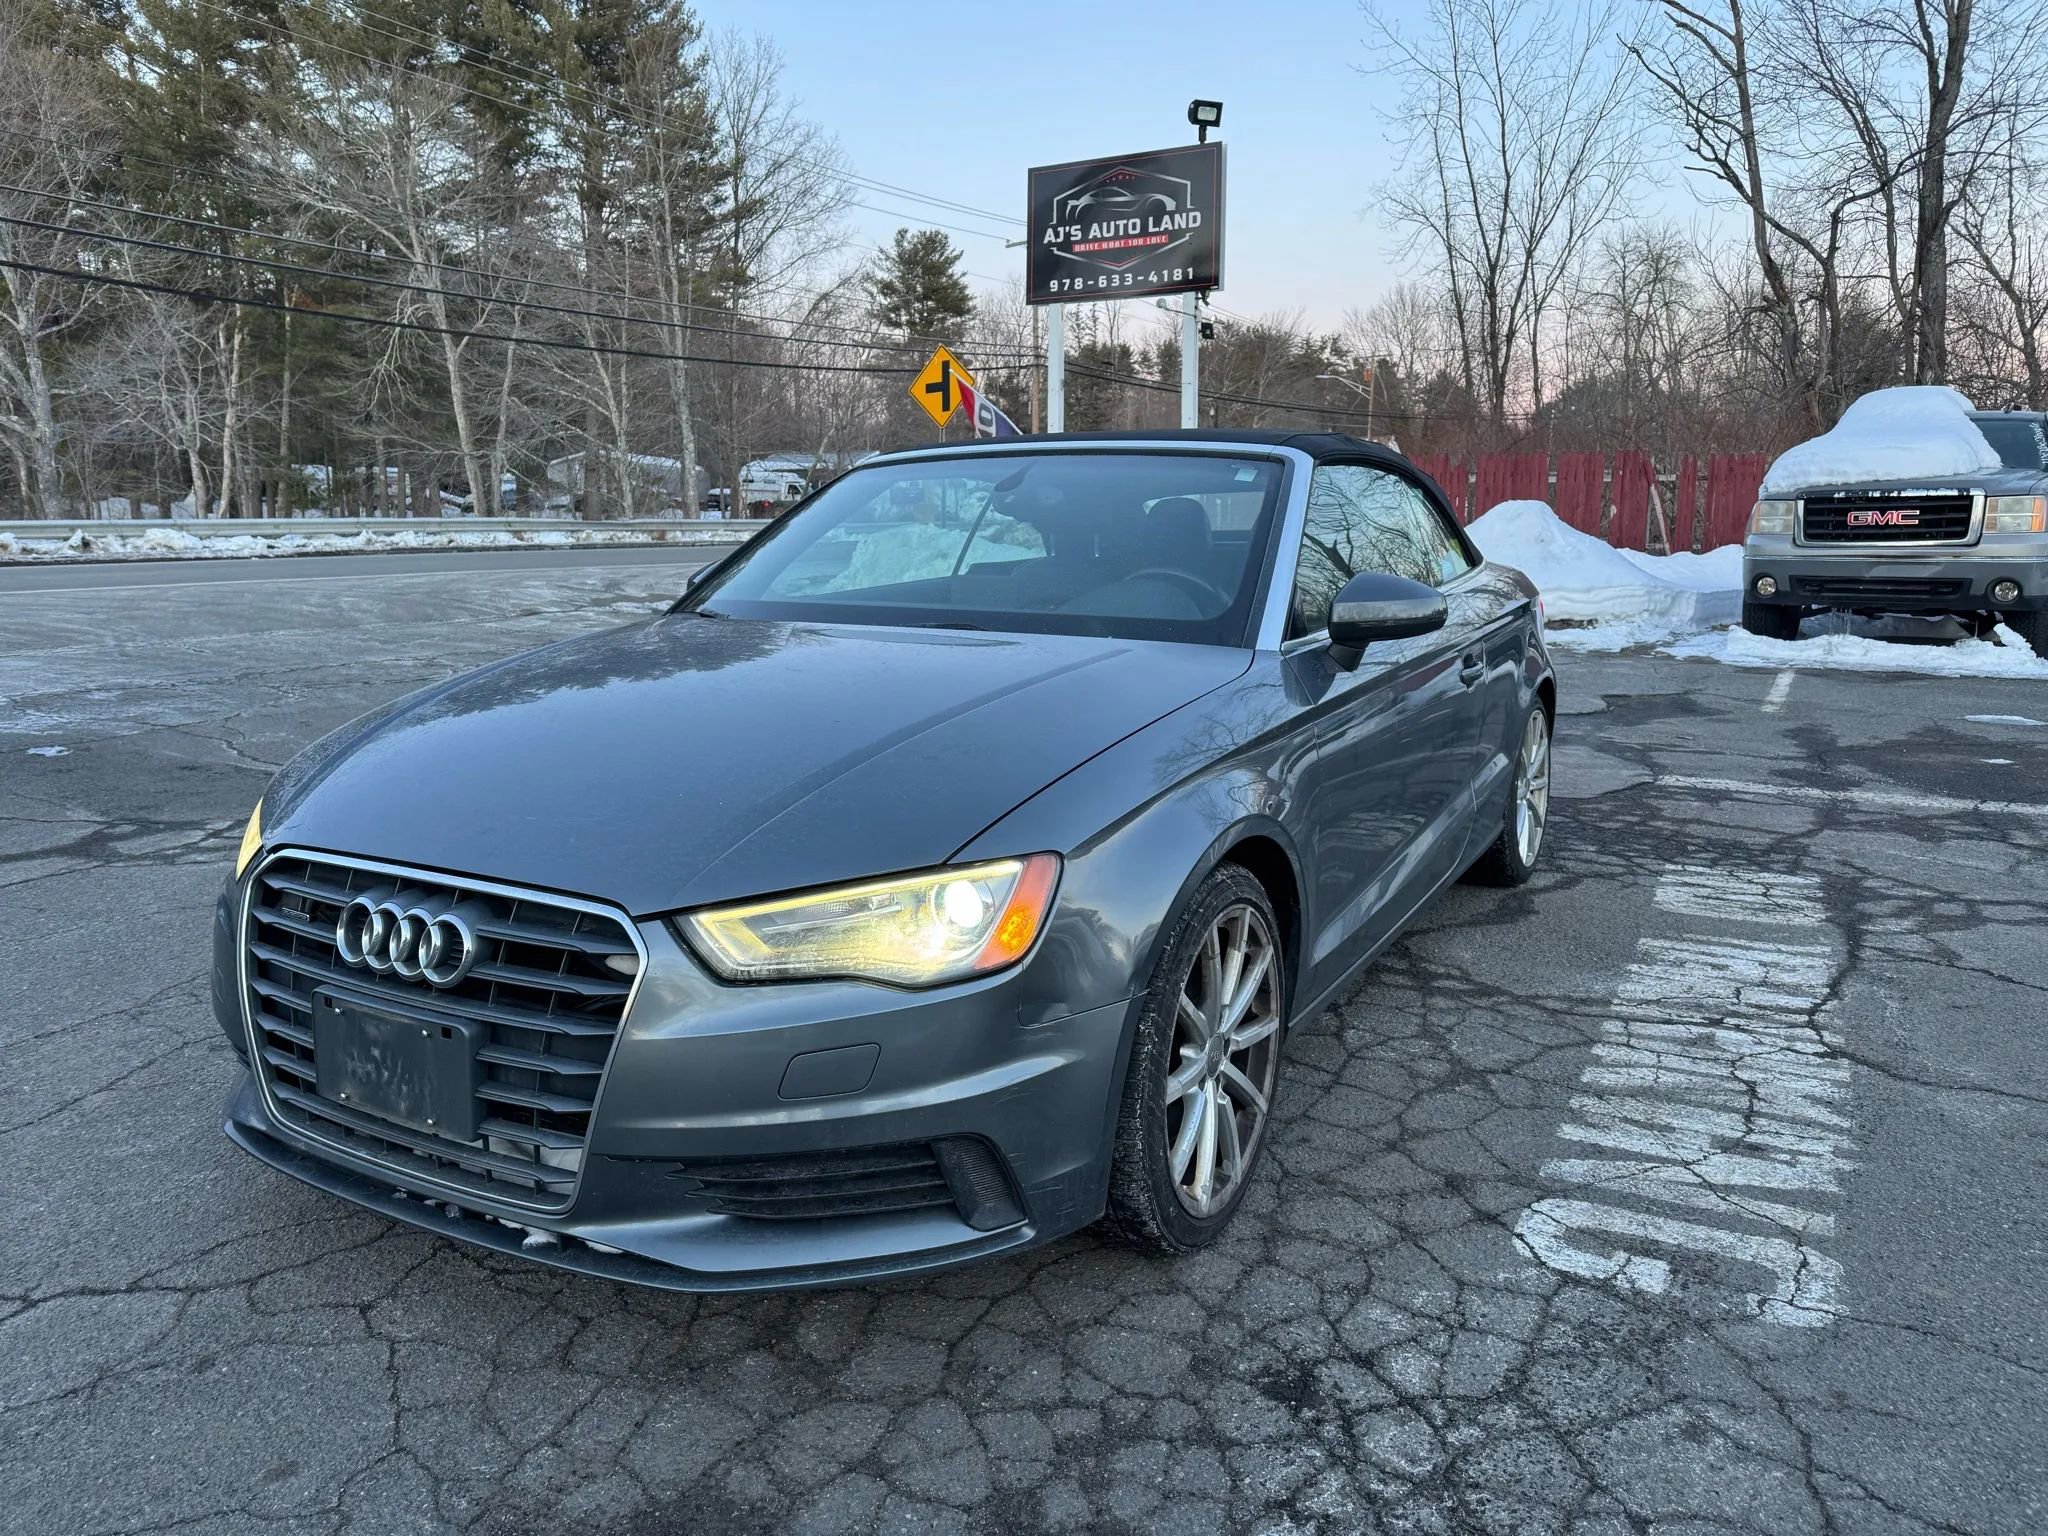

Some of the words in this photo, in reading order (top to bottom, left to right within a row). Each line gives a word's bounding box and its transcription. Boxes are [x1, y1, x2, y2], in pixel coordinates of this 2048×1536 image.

[1043, 225, 1082, 244] AJ'S
[1088, 218, 1141, 239] AUTO
[1148, 211, 1202, 233] LAND
[1074, 243, 1099, 251] DRIVE
[1101, 240, 1125, 249] WHAT
[1128, 238, 1143, 247] YOU
[1147, 235, 1168, 245] LOVE
[1049, 267, 1195, 292] 978-633-4181
[1847, 510, 1920, 526] GMC
